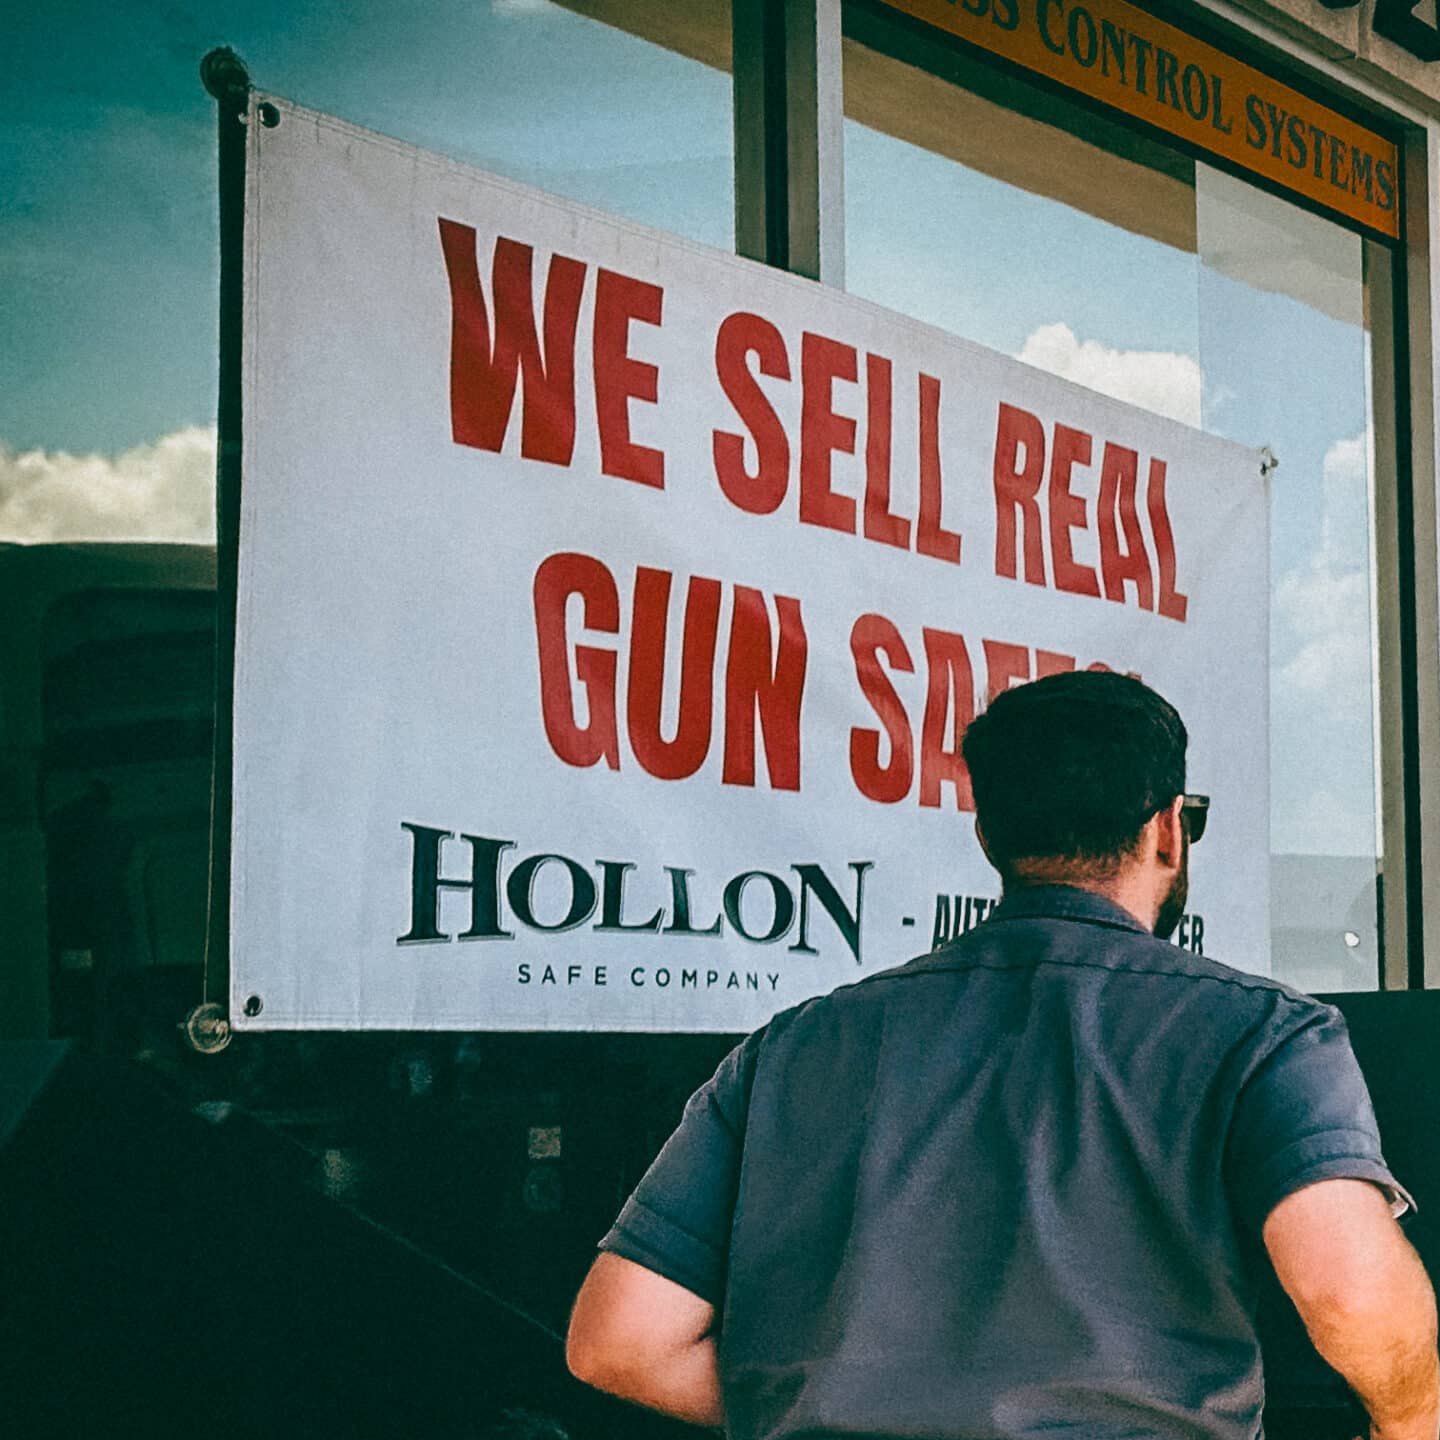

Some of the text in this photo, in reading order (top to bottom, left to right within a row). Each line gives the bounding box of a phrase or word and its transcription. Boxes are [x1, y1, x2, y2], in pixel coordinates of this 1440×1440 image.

[1036, 0, 1394, 211] CONTROL SYSTEMS
[437, 217, 1189, 622] WE SELL REAL
[532, 552, 807, 791] GUN
[396, 821, 875, 965] HOLLON
[518, 963, 781, 991] SAFE COMPANY
